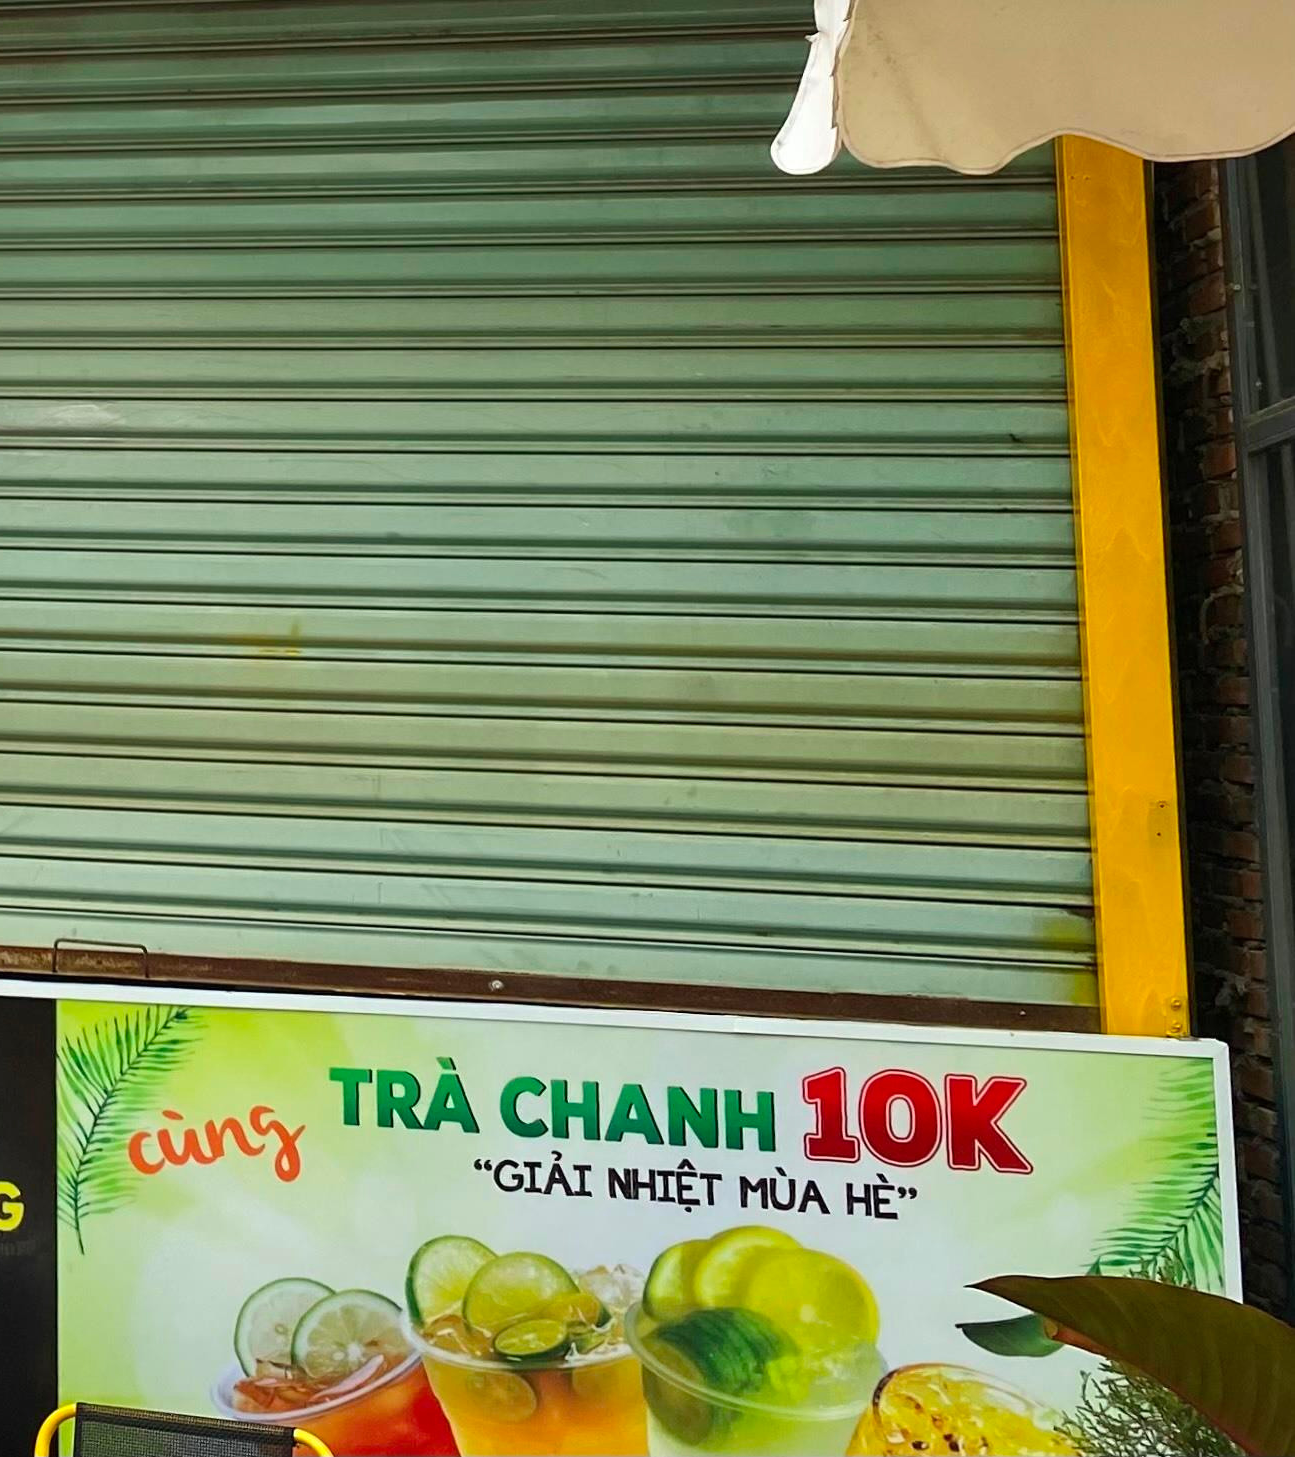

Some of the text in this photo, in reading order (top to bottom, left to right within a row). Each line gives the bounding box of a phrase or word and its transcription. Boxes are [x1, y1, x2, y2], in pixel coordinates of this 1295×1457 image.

[126, 1104, 304, 1184] cùng
[323, 1055, 1033, 1175] TRÀ CHANH 10K
[607, 1158, 723, 1213] NHIỆT
[739, 1166, 831, 1215] MÙA
